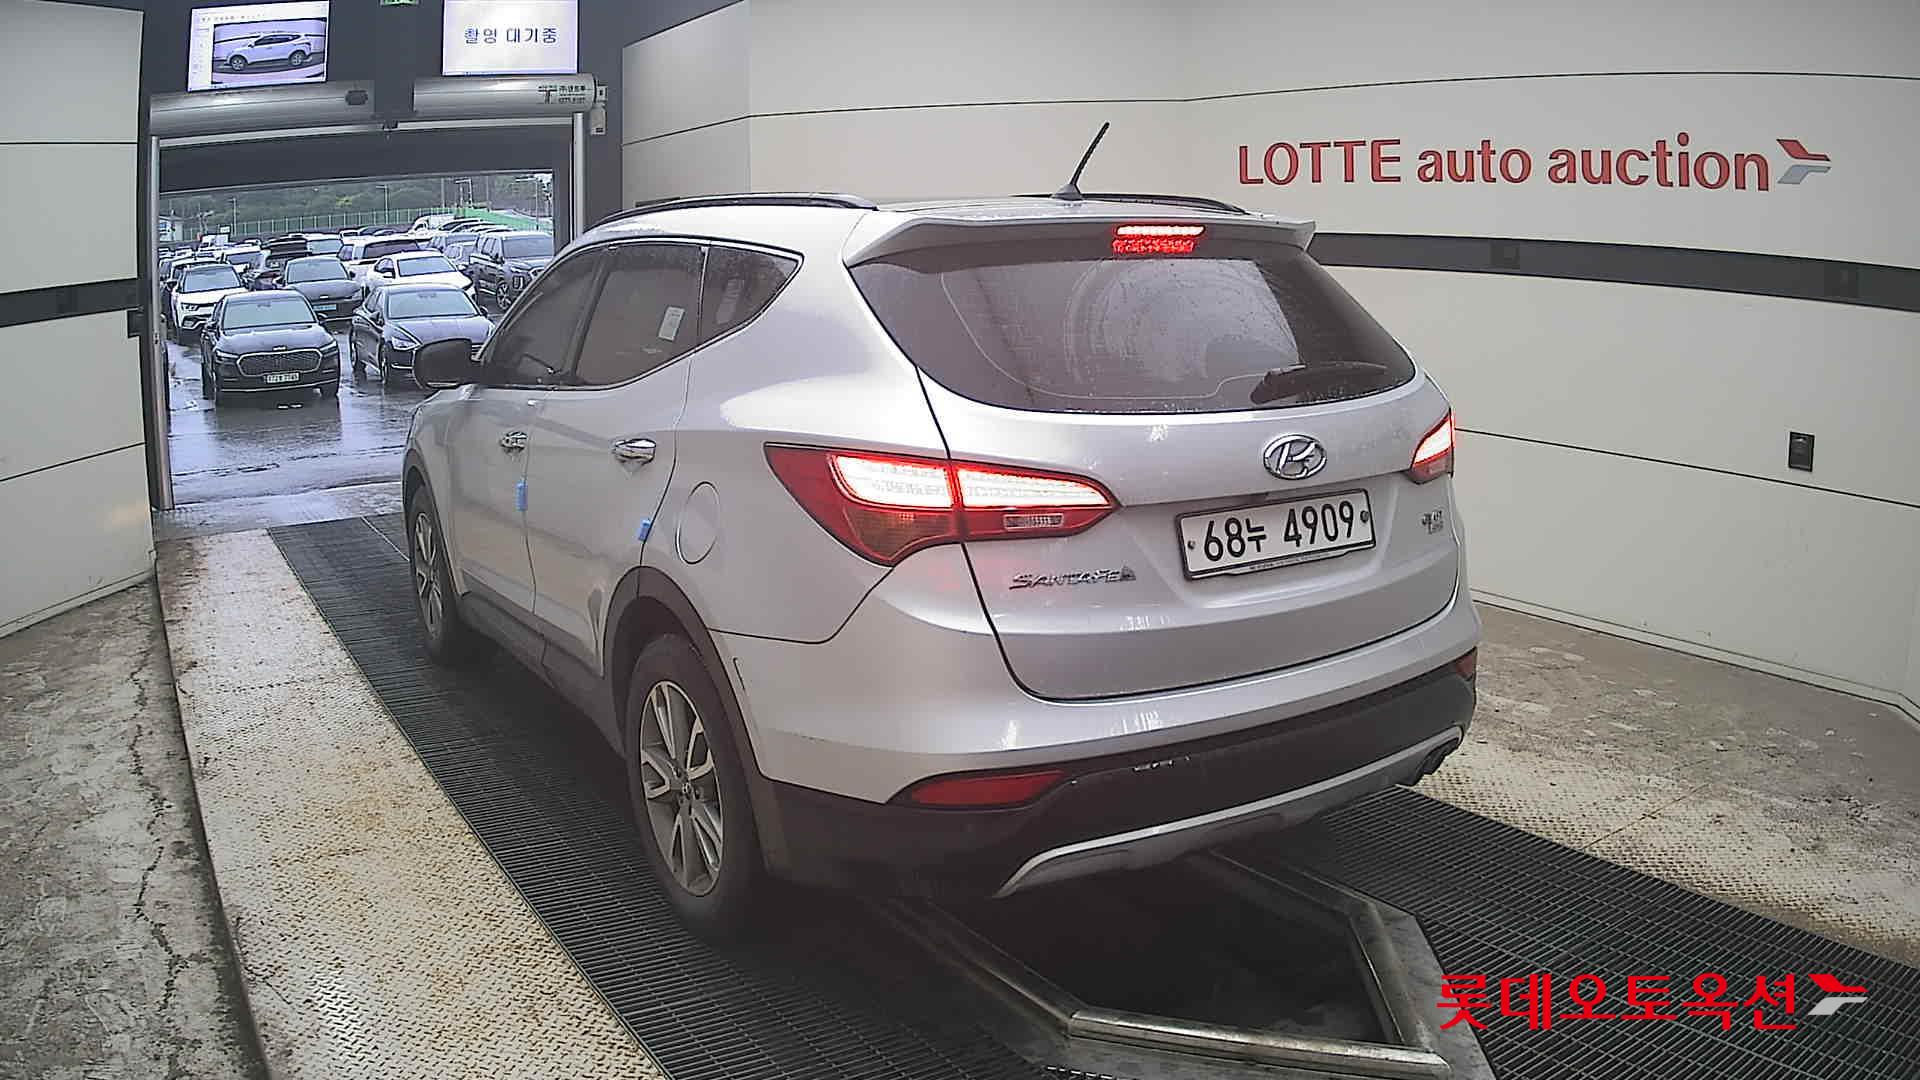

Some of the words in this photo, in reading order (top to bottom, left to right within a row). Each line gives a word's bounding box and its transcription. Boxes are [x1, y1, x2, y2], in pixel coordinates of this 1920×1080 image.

[464, 27, 497, 44] 촬영
[506, 27, 557, 44] 대기중
[1239, 139, 1401, 185] LOTTE
[1417, 140, 1532, 183] auto
[1549, 132, 1769, 191] auction
[1204, 517, 1266, 561] 68누
[1284, 501, 1354, 547] 4909
